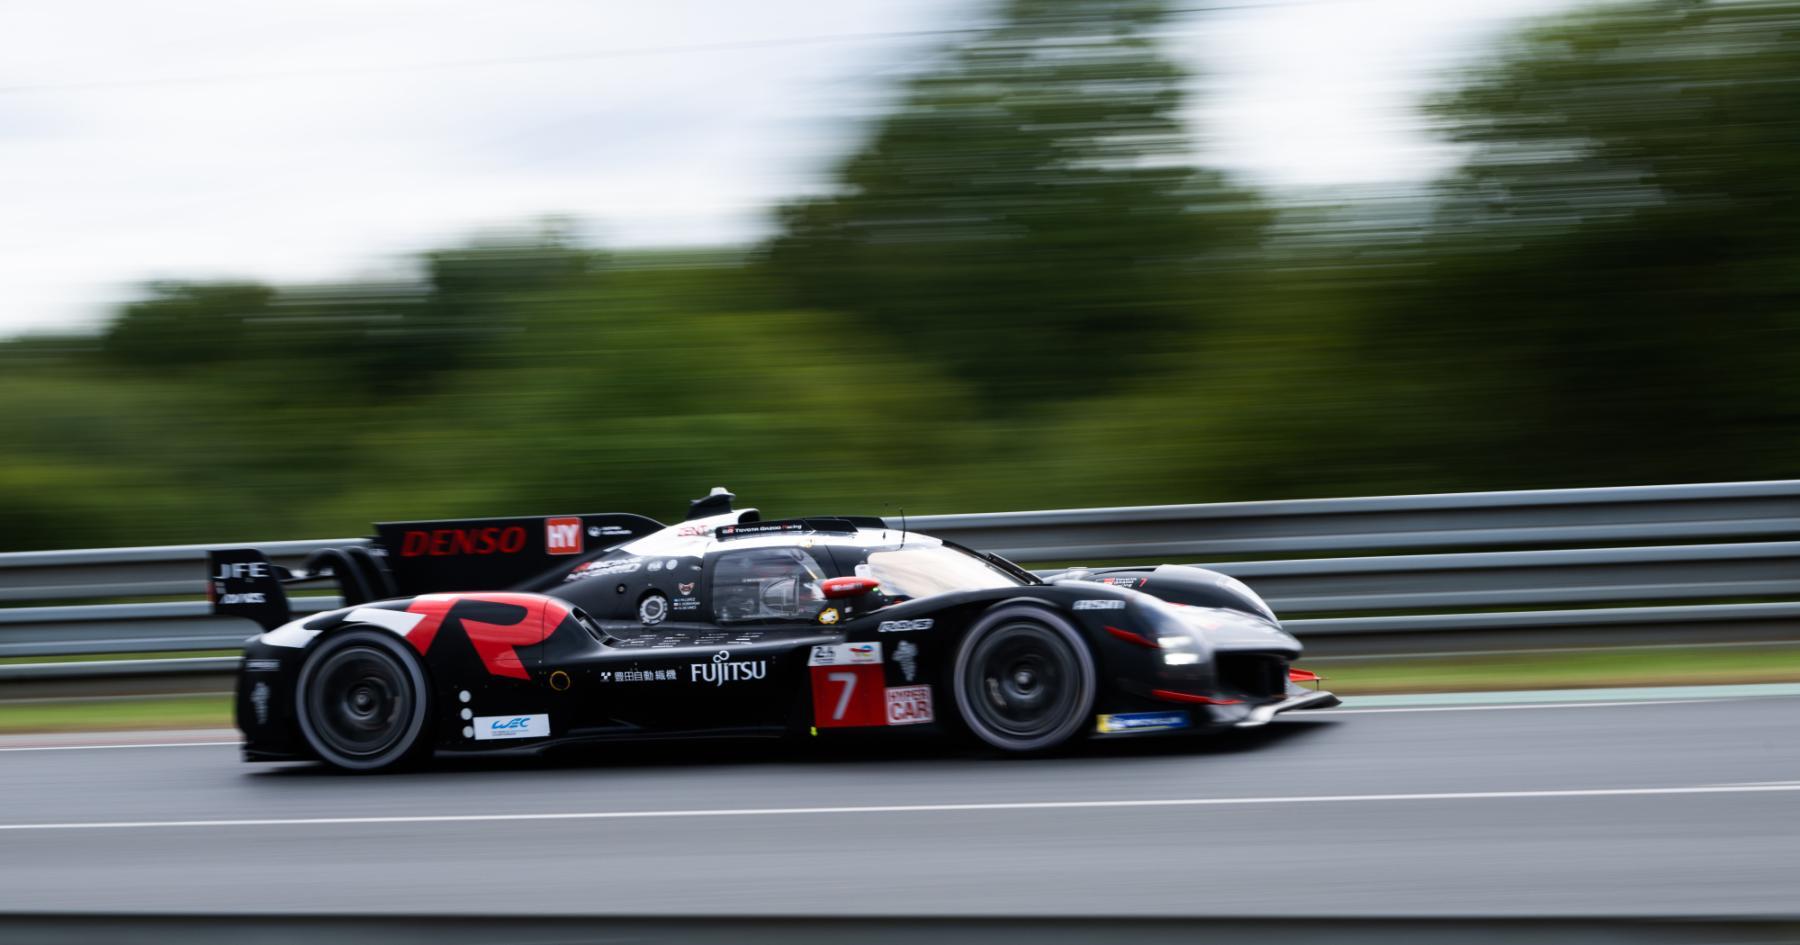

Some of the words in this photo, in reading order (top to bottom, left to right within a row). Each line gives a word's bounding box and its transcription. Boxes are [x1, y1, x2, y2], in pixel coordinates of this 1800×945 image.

[402, 526, 527, 557] DENSO
[547, 525, 578, 547] HY
[213, 562, 269, 579] JFE
[691, 658, 767, 687] FUJITSU
[827, 671, 858, 721] 7
[887, 688, 930, 700] HYPER
[890, 700, 931, 721] CAR
[491, 717, 530, 730] WEC
